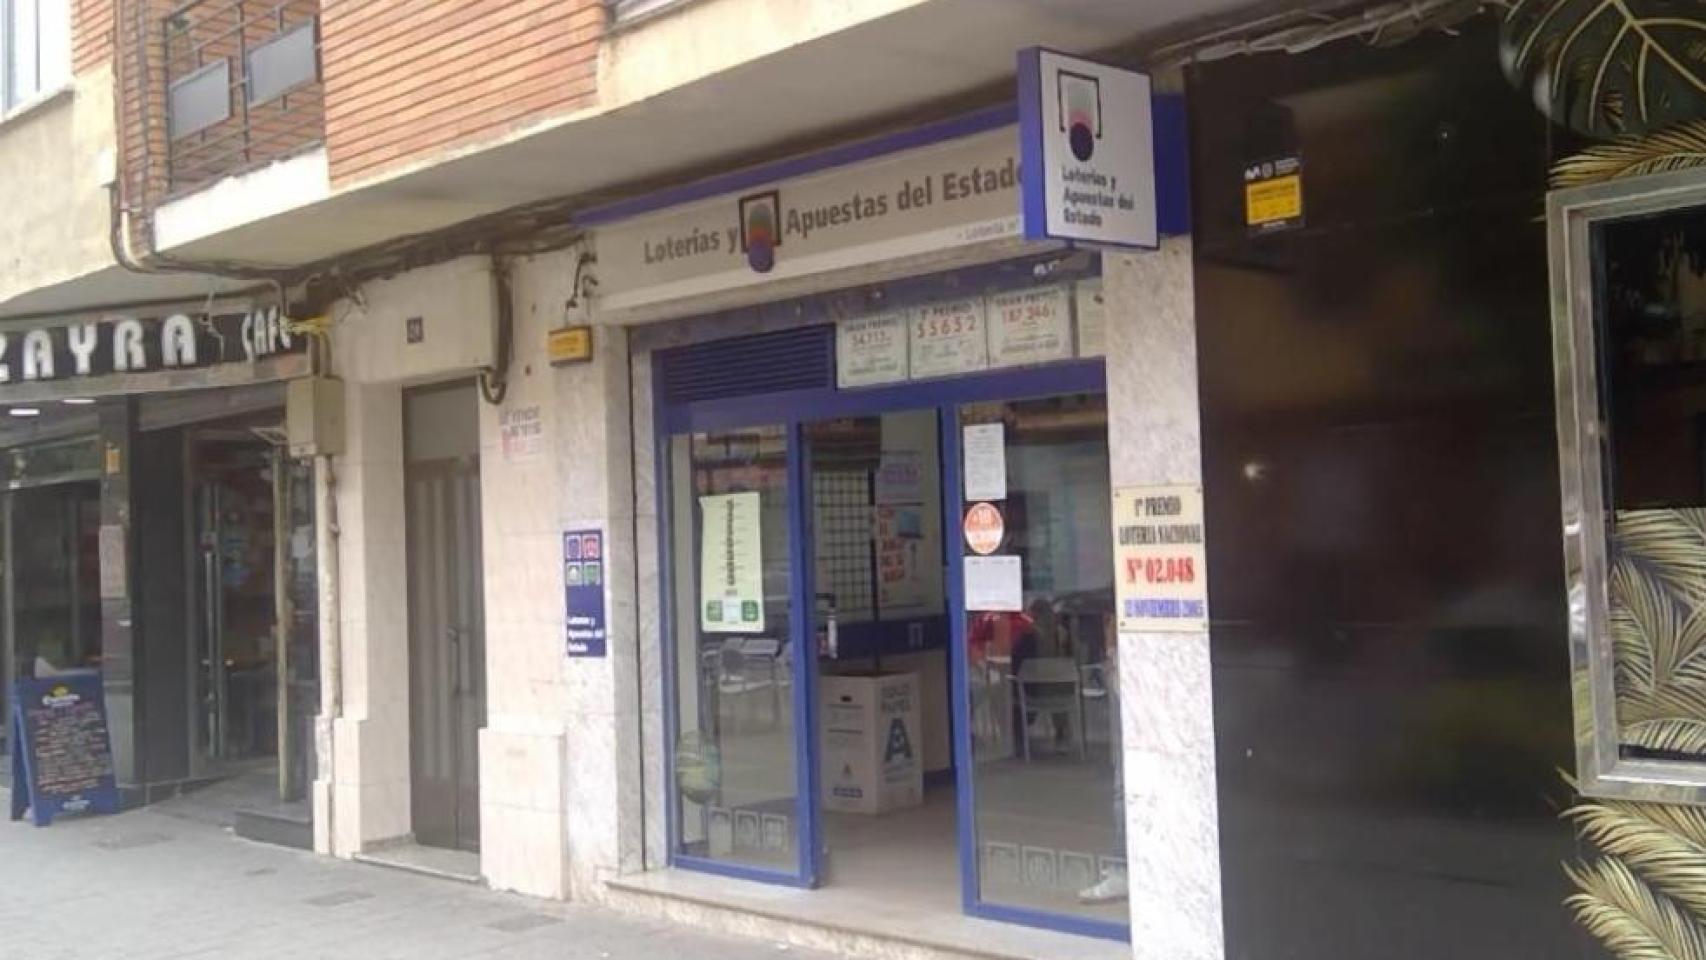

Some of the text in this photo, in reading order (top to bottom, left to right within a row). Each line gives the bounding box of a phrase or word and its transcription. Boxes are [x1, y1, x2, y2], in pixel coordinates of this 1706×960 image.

[1110, 176, 1117, 193] y
[1064, 187, 1135, 211] Apuestas del
[644, 227, 720, 265] Loterías
[727, 226, 739, 255] y
[786, 195, 888, 238] Apuestas
[897, 175, 933, 211] del
[1064, 207, 1103, 227] Estado
[933, 303, 972, 315] PREMIO
[1145, 496, 1181, 516] PREMIO
[1158, 524, 1202, 544] NACIONAL
